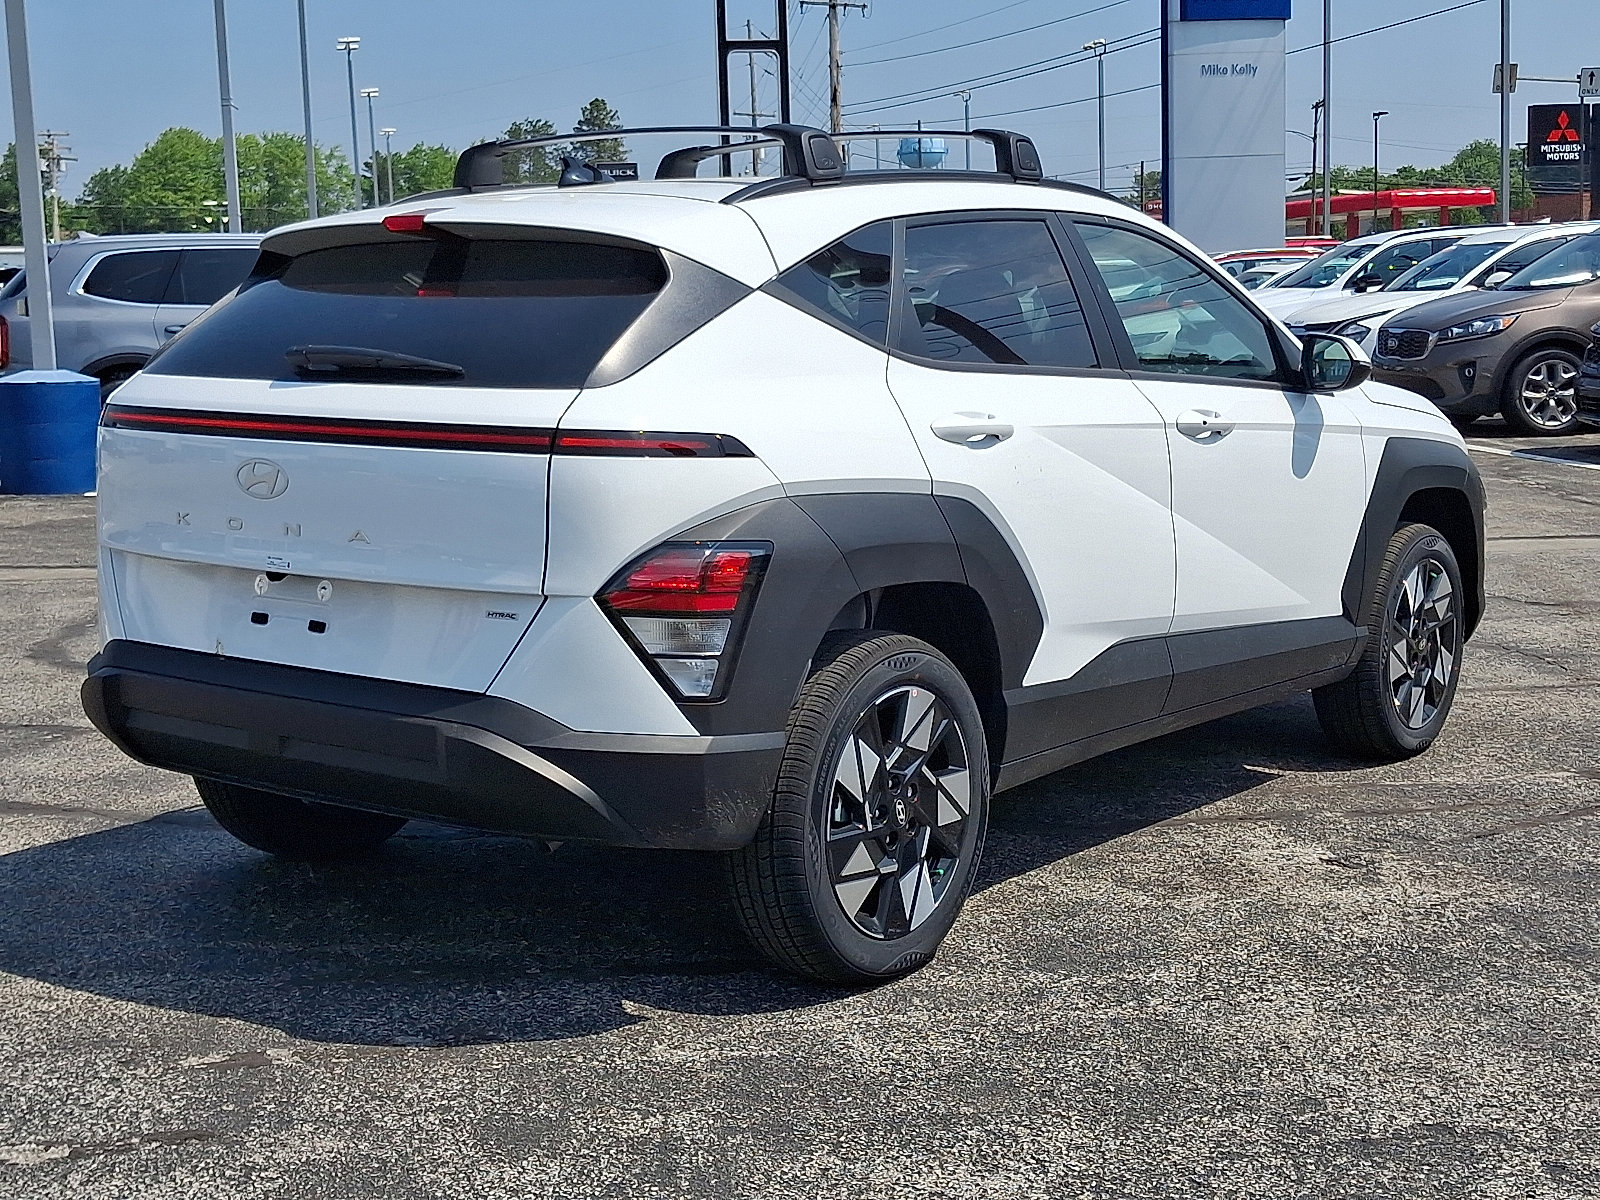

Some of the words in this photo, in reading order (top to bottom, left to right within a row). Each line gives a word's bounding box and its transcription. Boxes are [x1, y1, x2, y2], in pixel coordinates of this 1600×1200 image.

[1540, 143, 1586, 153] MITSUBISHI
[1546, 152, 1580, 161] MOTORS
[487, 611, 517, 620] HTRAC
